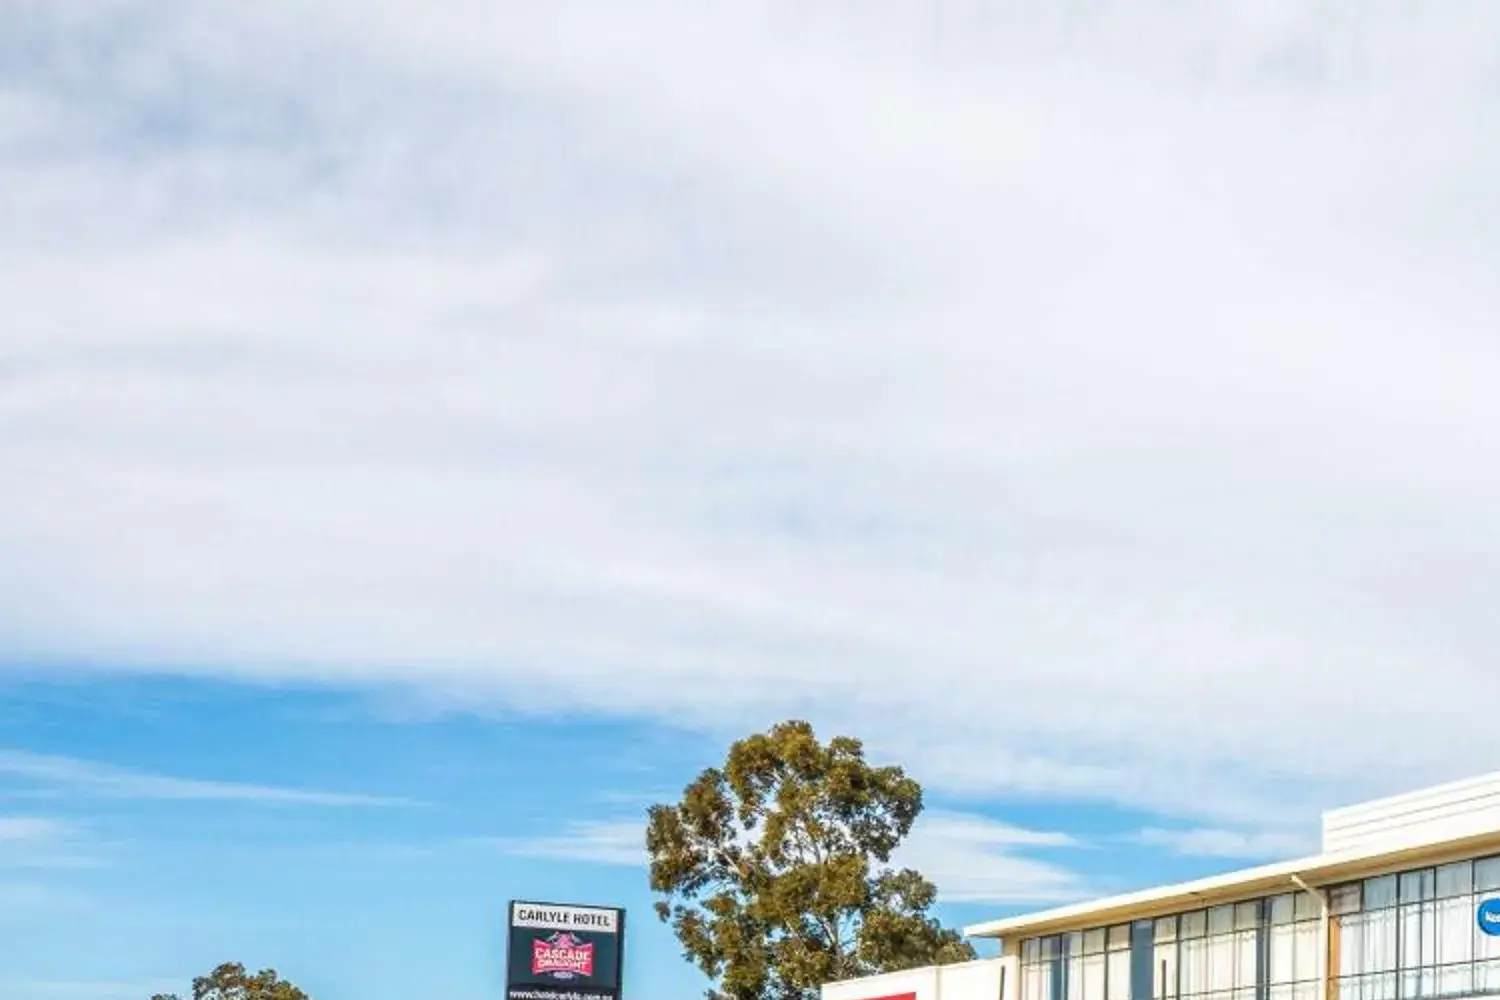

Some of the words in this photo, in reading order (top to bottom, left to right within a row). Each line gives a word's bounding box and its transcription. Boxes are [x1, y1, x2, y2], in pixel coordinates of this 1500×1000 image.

[519, 909, 568, 924] CARLYLE
[573, 912, 610, 927] HOTEL
[535, 947, 588, 961] CASCADE
